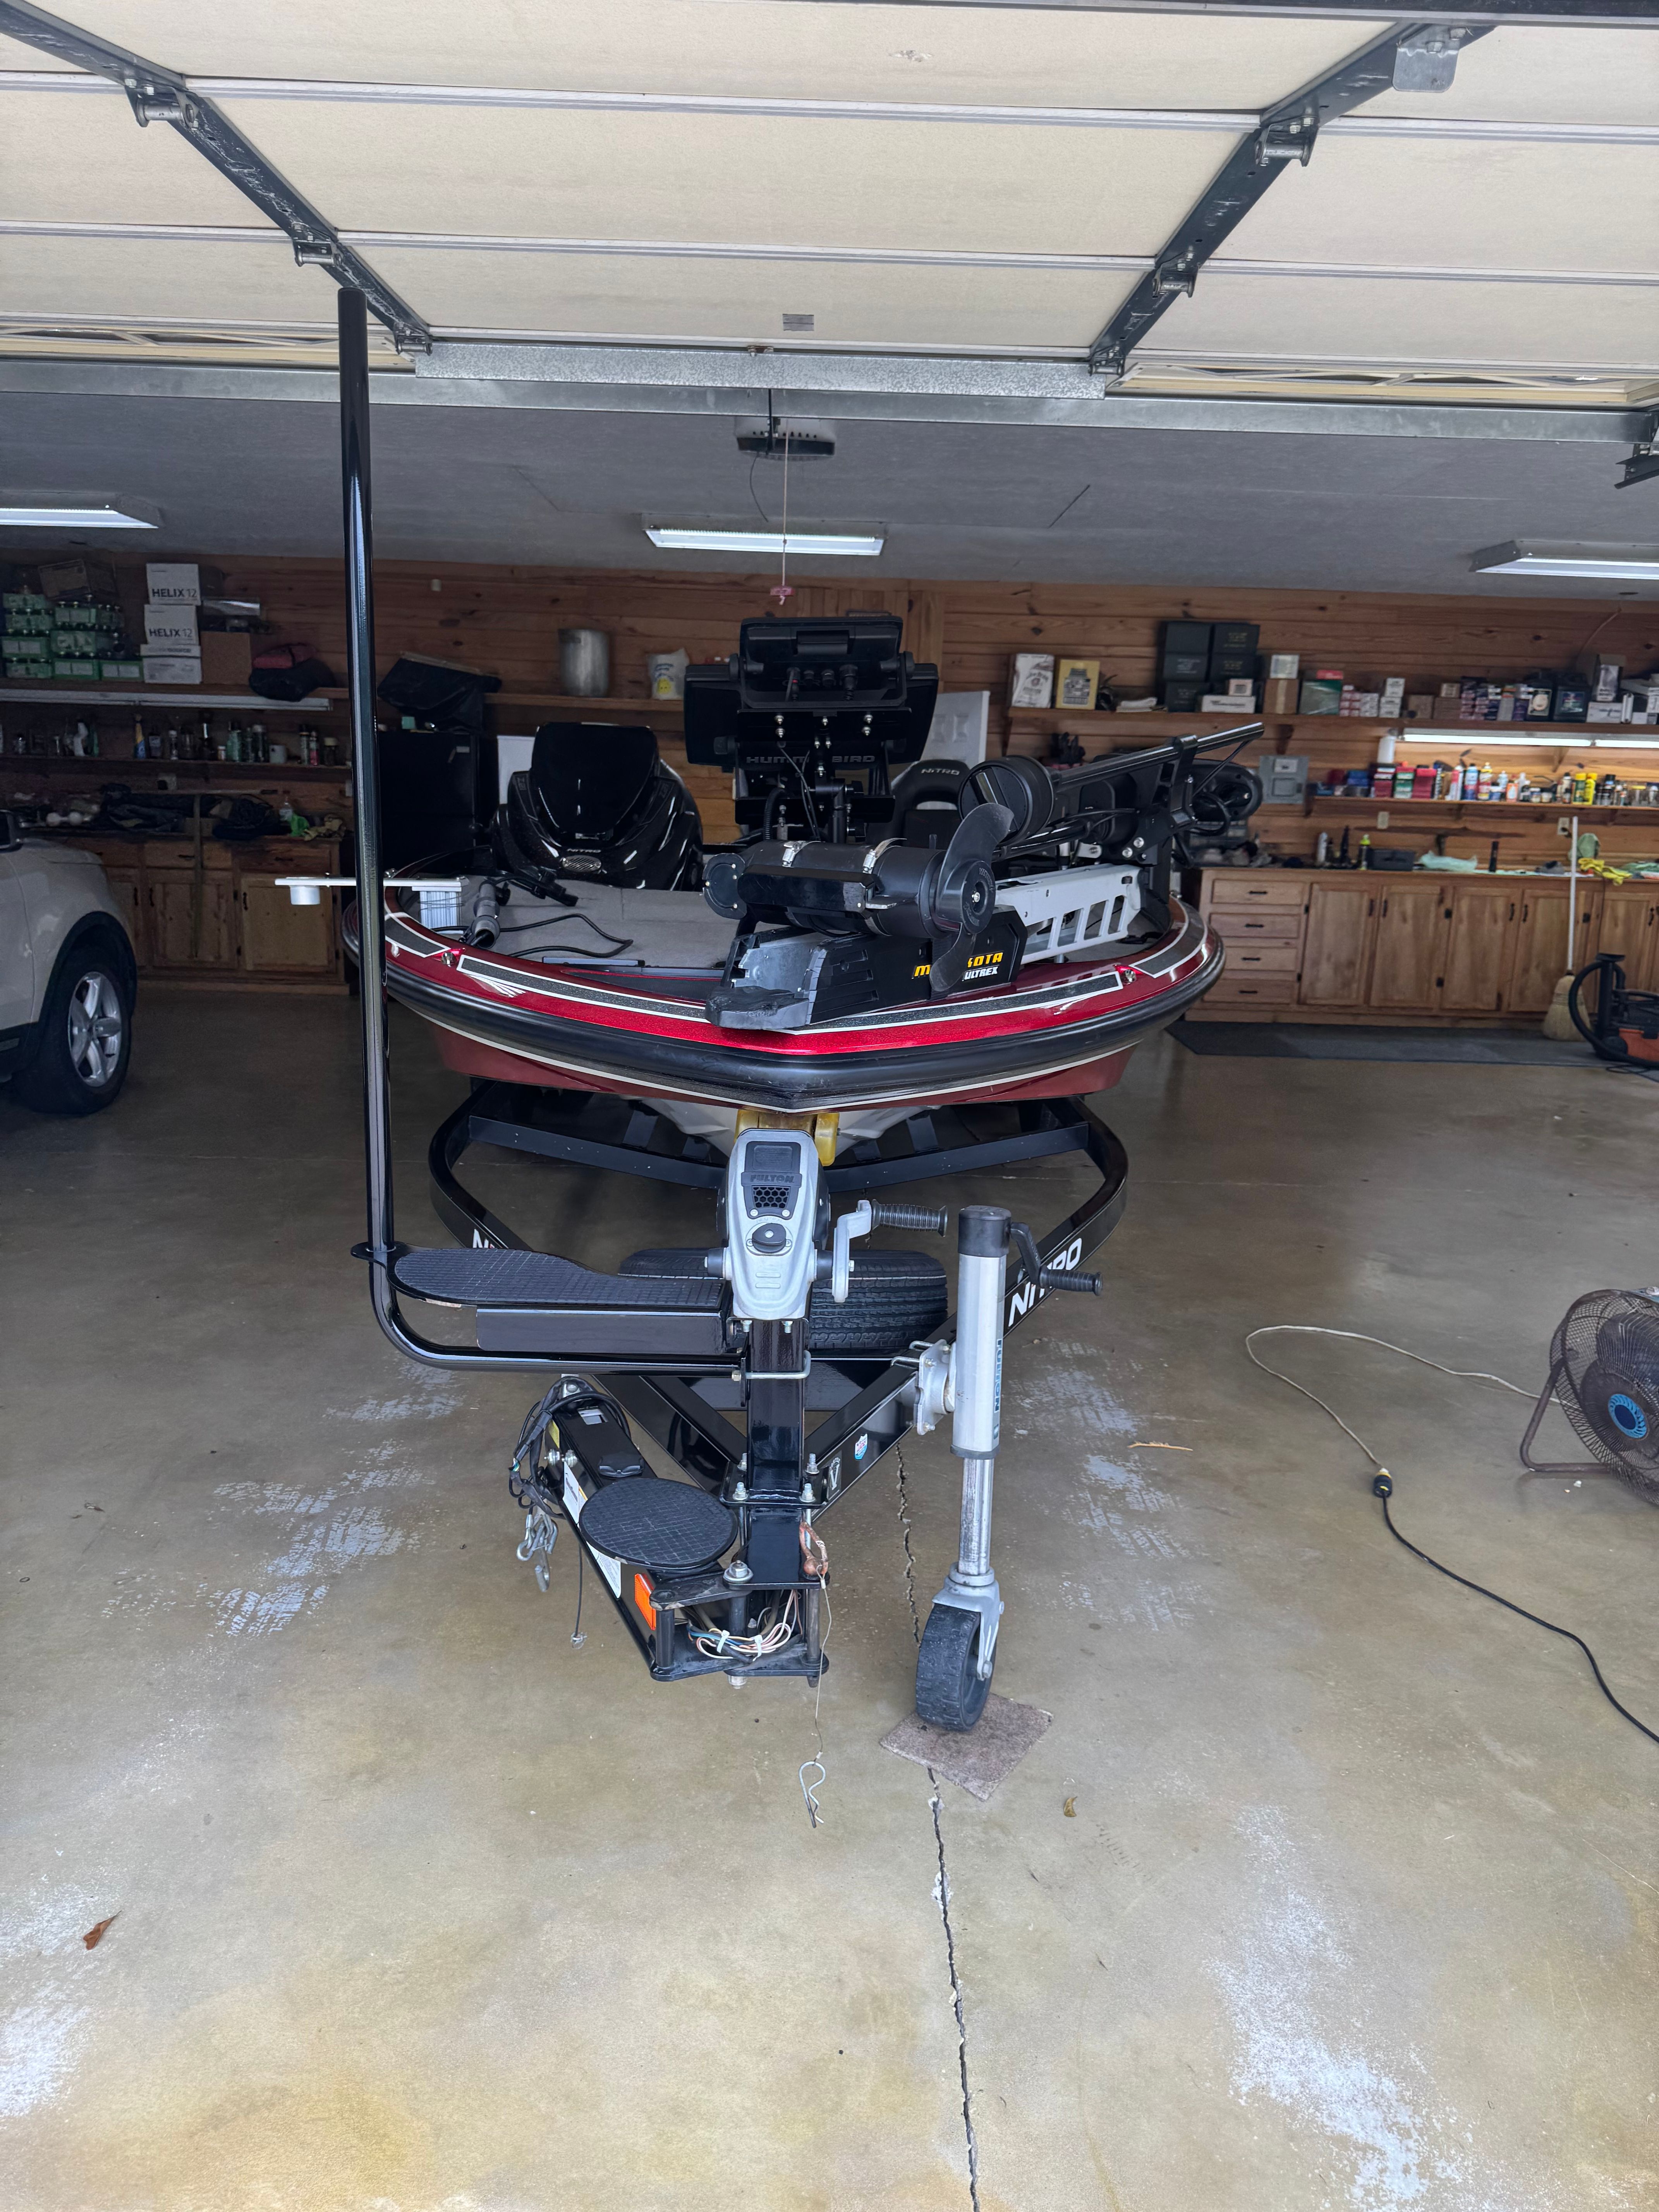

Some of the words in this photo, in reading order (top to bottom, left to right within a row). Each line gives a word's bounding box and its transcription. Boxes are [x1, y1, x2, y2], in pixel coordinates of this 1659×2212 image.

[152, 588, 184, 598] HELIX
[187, 589, 198, 598] 12
[149, 629, 180, 637] HELIX
[182, 629, 192, 638] 12
[964, 966, 999, 981] ULTREX
[750, 1175, 795, 1183] FULTON
[1008, 1238, 1082, 1327] NIRO
